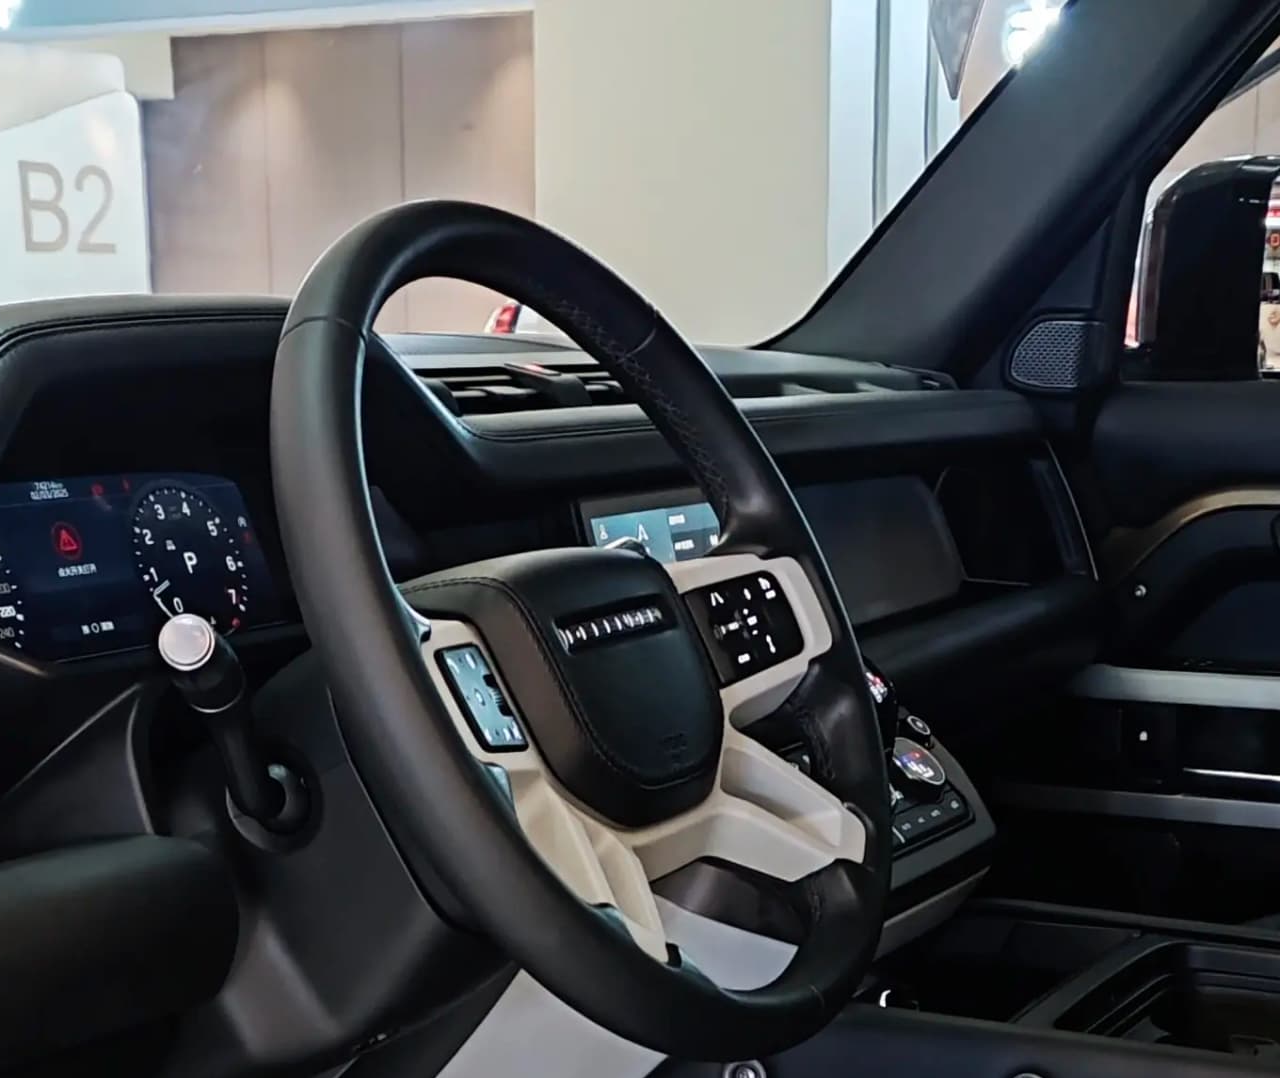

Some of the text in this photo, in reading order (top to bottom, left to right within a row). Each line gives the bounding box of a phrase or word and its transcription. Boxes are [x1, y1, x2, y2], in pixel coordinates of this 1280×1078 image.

[17, 159, 117, 254] B2
[154, 503, 166, 520] 3
[181, 501, 191, 517] 4
[142, 528, 155, 545] 2
[206, 520, 218, 537] 5
[183, 551, 198, 574] P
[225, 555, 237, 572] 6
[149, 567, 159, 582] 1
[173, 596, 184, 614] 0
[227, 588, 237, 605] 7
